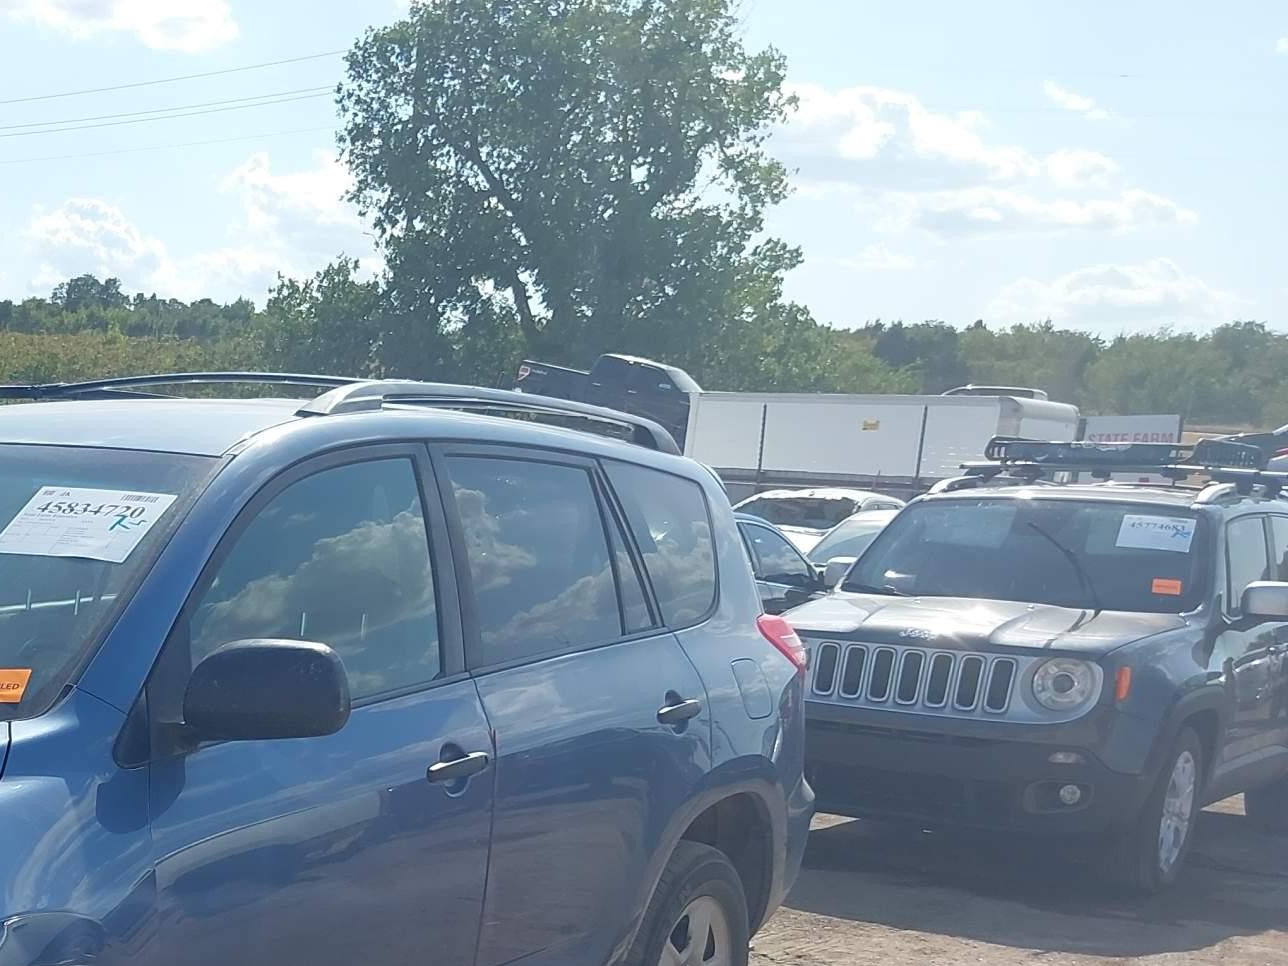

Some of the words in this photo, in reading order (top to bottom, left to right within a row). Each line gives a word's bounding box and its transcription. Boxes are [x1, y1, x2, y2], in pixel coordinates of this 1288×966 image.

[1088, 432, 1130, 442] STATE
[1133, 432, 1175, 442] FARM
[36, 501, 146, 519] 45834720
